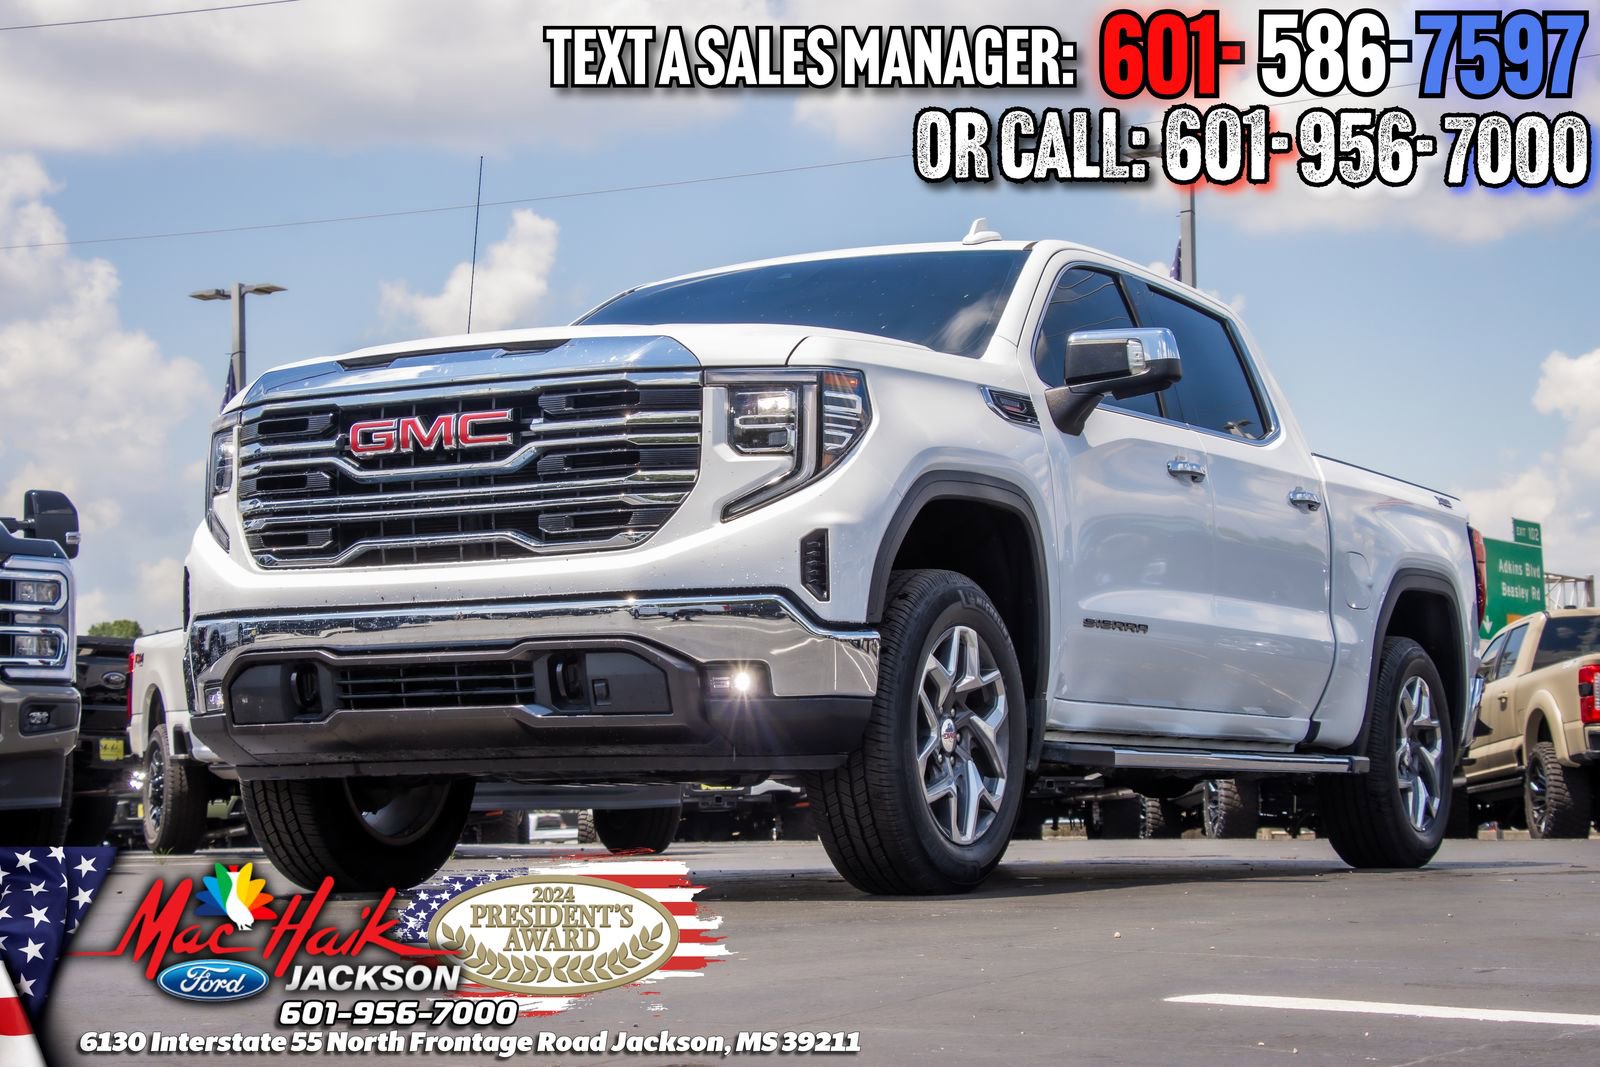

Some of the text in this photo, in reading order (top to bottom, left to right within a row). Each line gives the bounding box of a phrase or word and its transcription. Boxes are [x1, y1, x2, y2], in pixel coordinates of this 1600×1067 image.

[350, 408, 513, 459] GMC
[1498, 559, 1541, 579] Adkins Blvd
[1501, 582, 1541, 603] Beasley Rd
[1082, 618, 1148, 634] SIERRA
